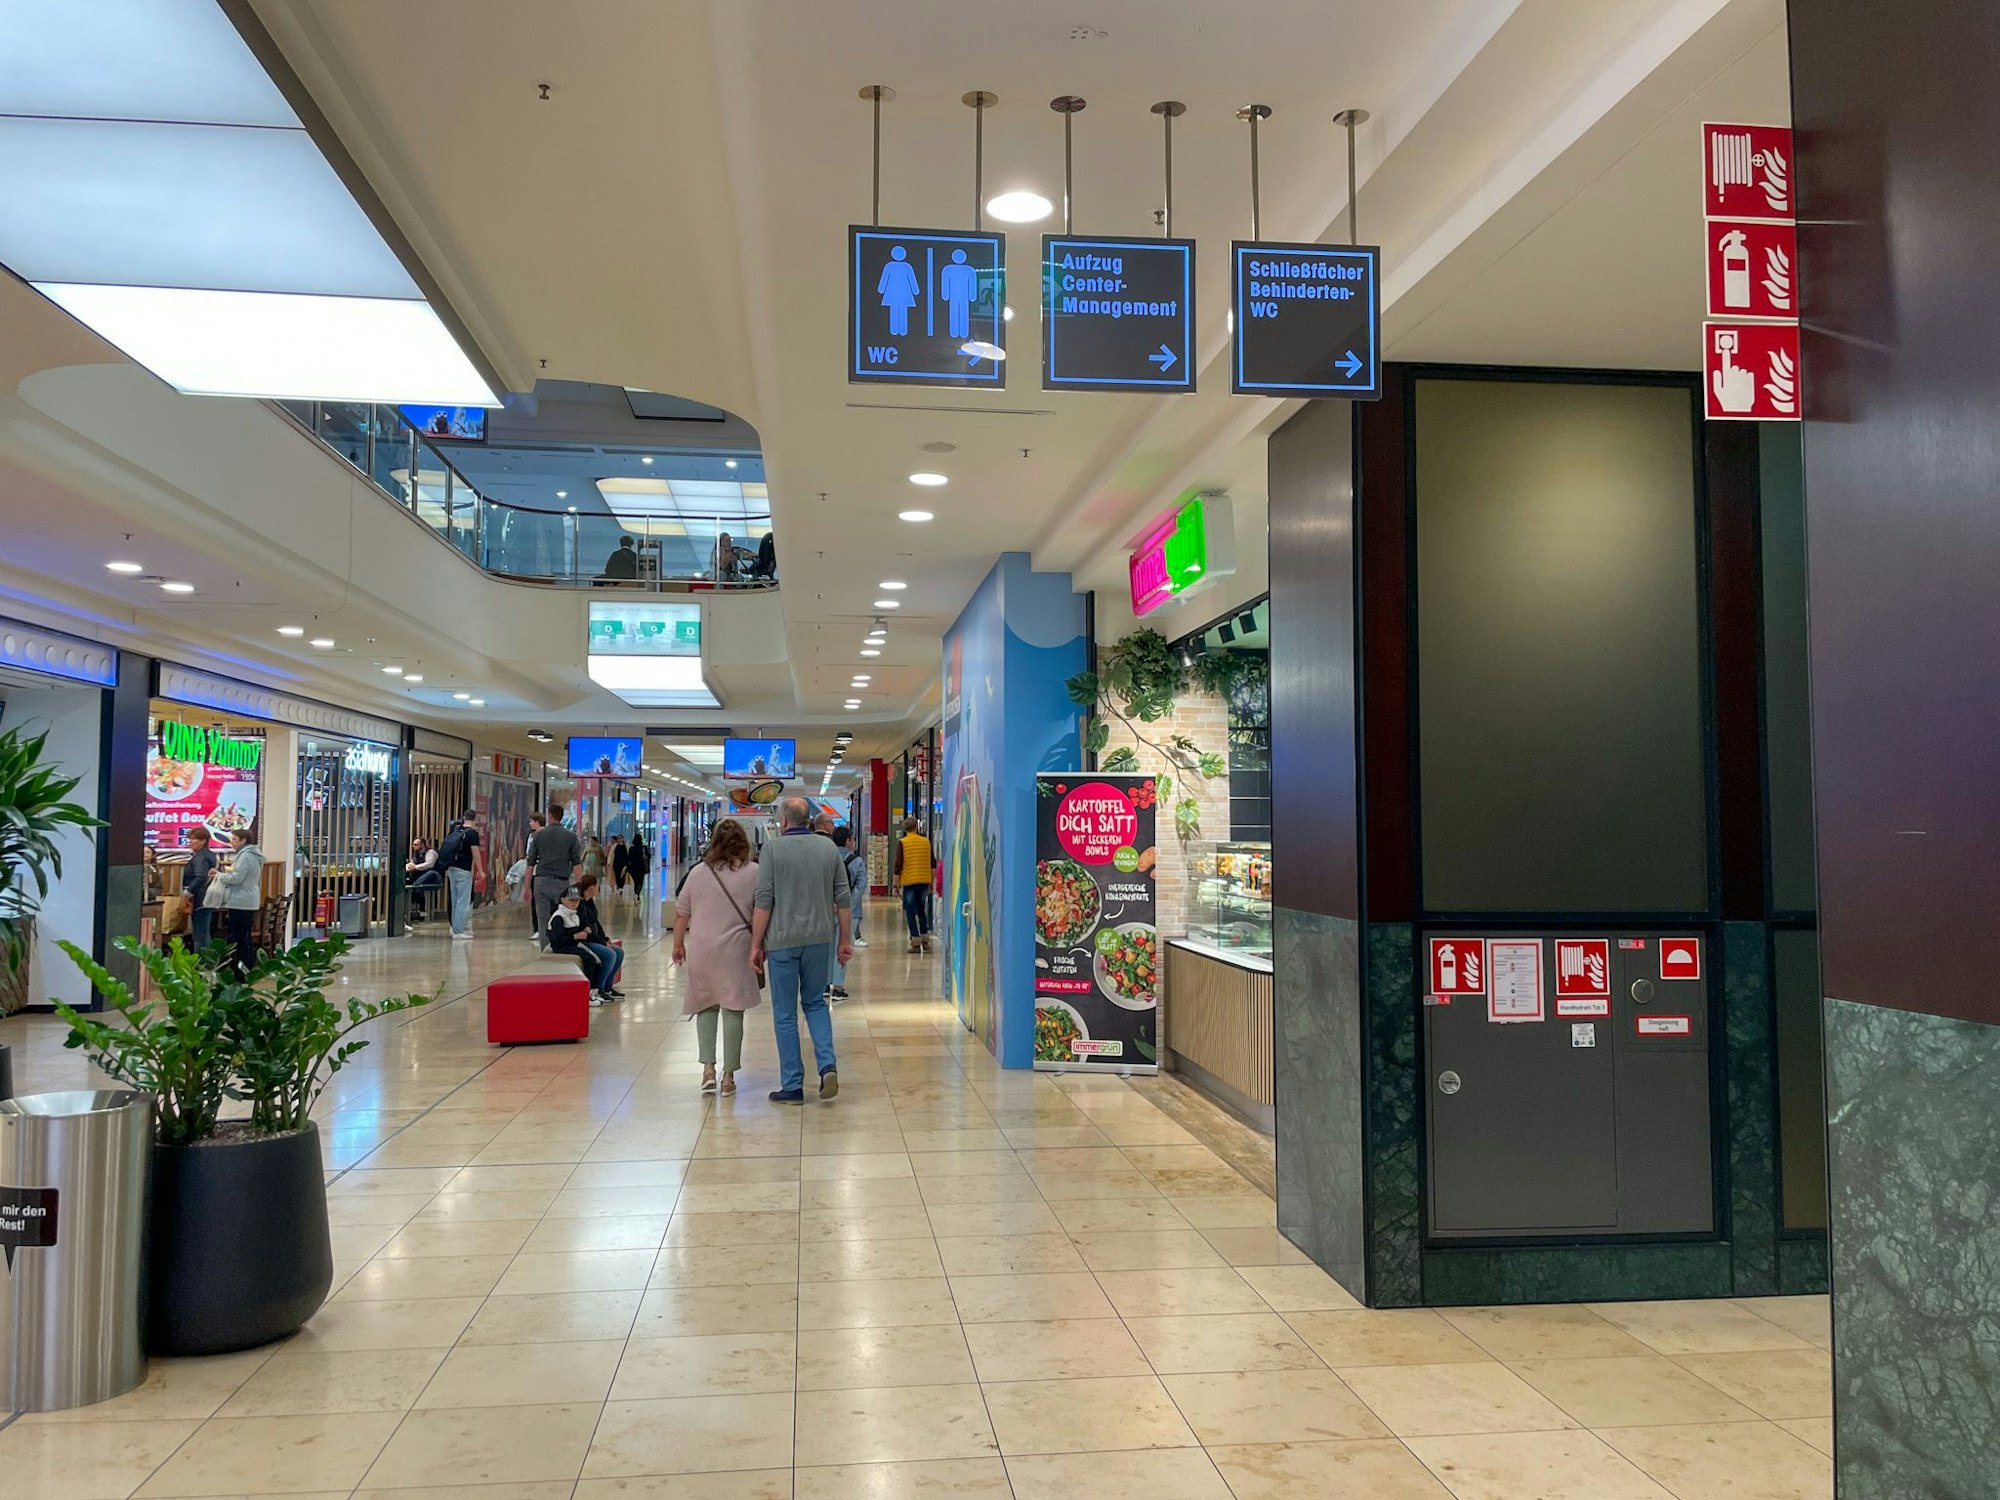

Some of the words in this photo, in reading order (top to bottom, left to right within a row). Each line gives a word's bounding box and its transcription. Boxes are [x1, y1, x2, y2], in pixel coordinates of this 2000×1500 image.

[1062, 253, 1123, 275] Aufzug
[1249, 260, 1364, 280] Schließfächer
[1062, 274, 1128, 293] Center-
[1250, 281, 1355, 300] Behinderten-
[1062, 296, 1177, 319] Management
[1249, 301, 1279, 318] WC
[867, 345, 899, 364] WC
[208, 729, 261, 769] Yummy
[1068, 799, 1125, 814] KARTOFFEL
[145, 811, 179, 823] uffet
[181, 811, 206, 823] Box
[1098, 815, 1135, 833] SATT
[1072, 835, 1086, 845] MIT
[1088, 835, 1122, 845] LECKEREN
[1085, 845, 1110, 856] BOWLS
[1075, 1042, 1119, 1053] immergrün
[2, 1204, 20, 1216] mir
[22, 1204, 47, 1217] den
[0, 1217, 26, 1231] Rest!
